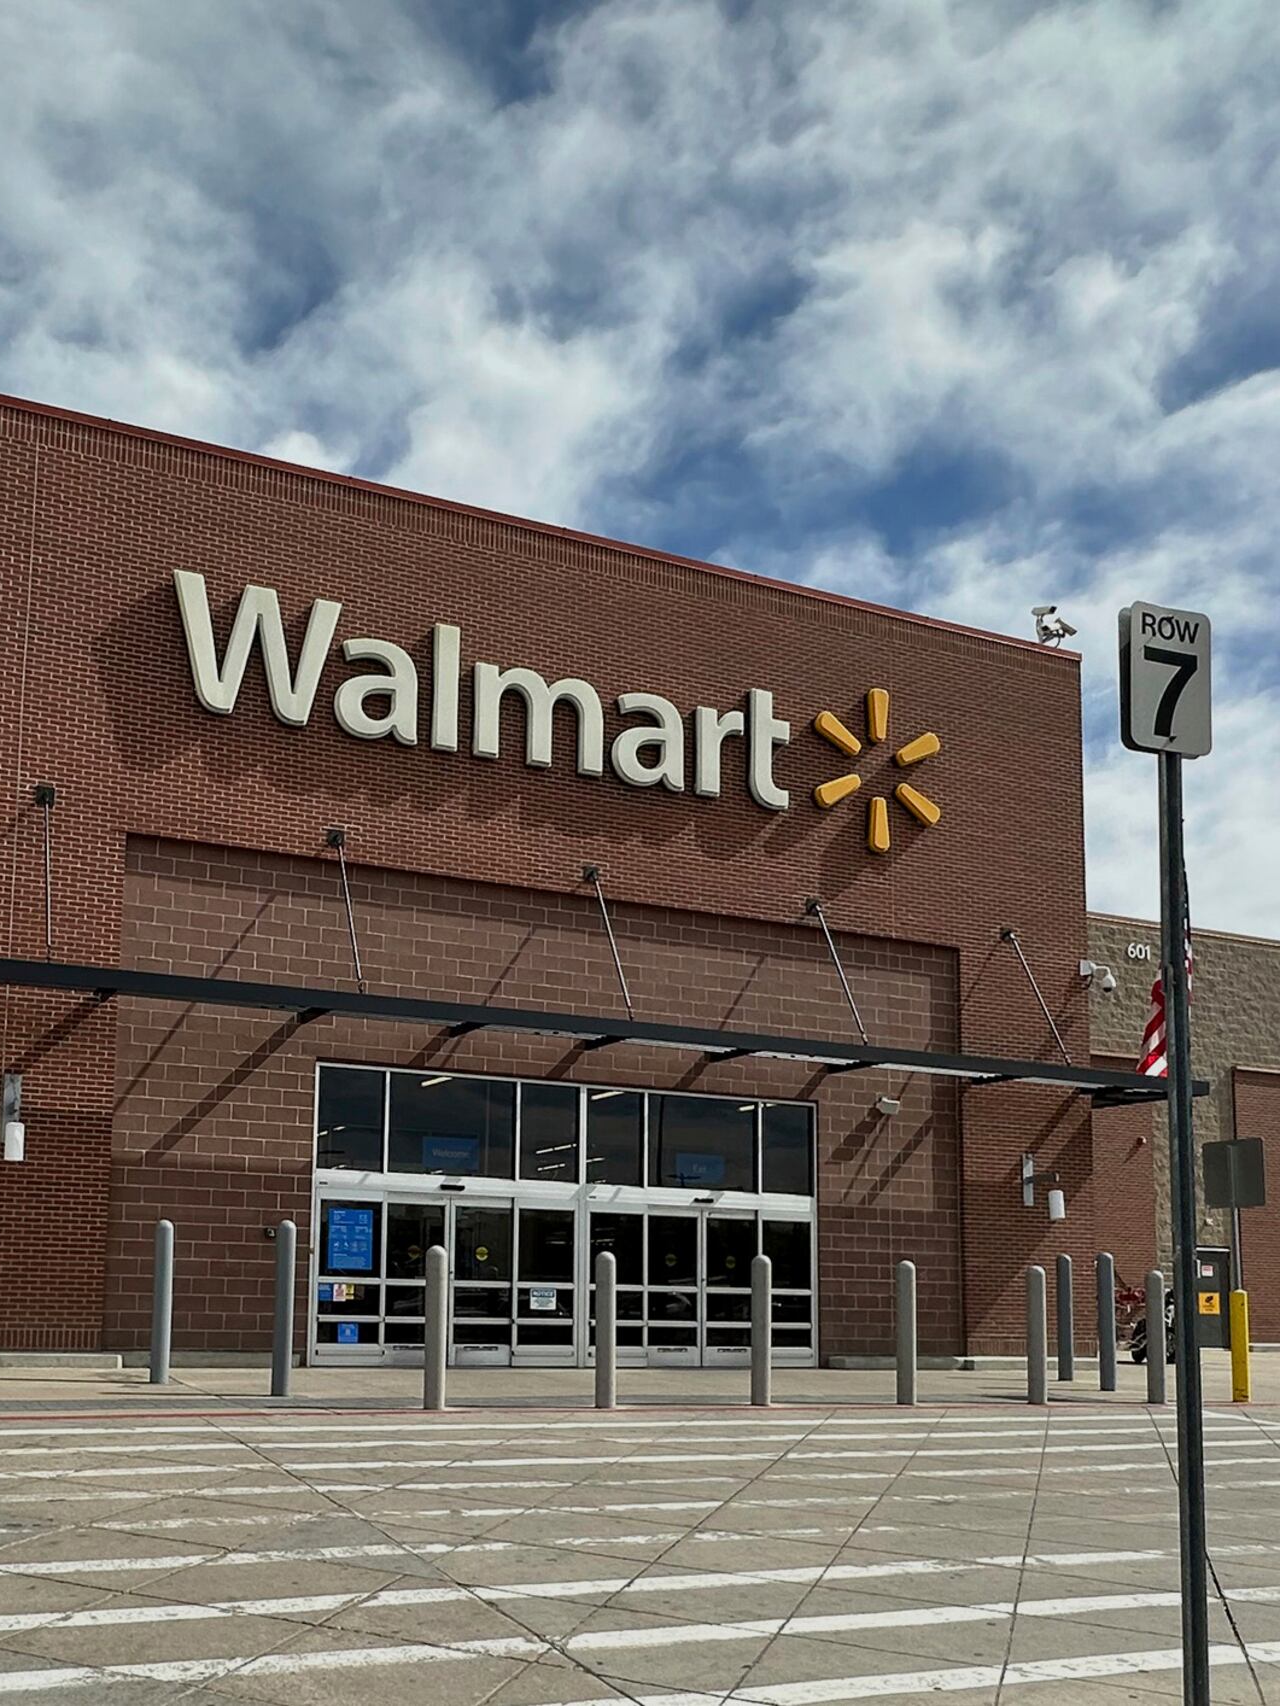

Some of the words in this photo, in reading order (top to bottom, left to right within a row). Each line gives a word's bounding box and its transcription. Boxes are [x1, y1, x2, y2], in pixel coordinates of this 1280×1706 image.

[1141, 611, 1199, 644] ROW
[173, 569, 790, 810] Walmart
[1143, 645, 1198, 738] 7
[1127, 942, 1151, 961] 601
[431, 1147, 471, 1160] Welcome
